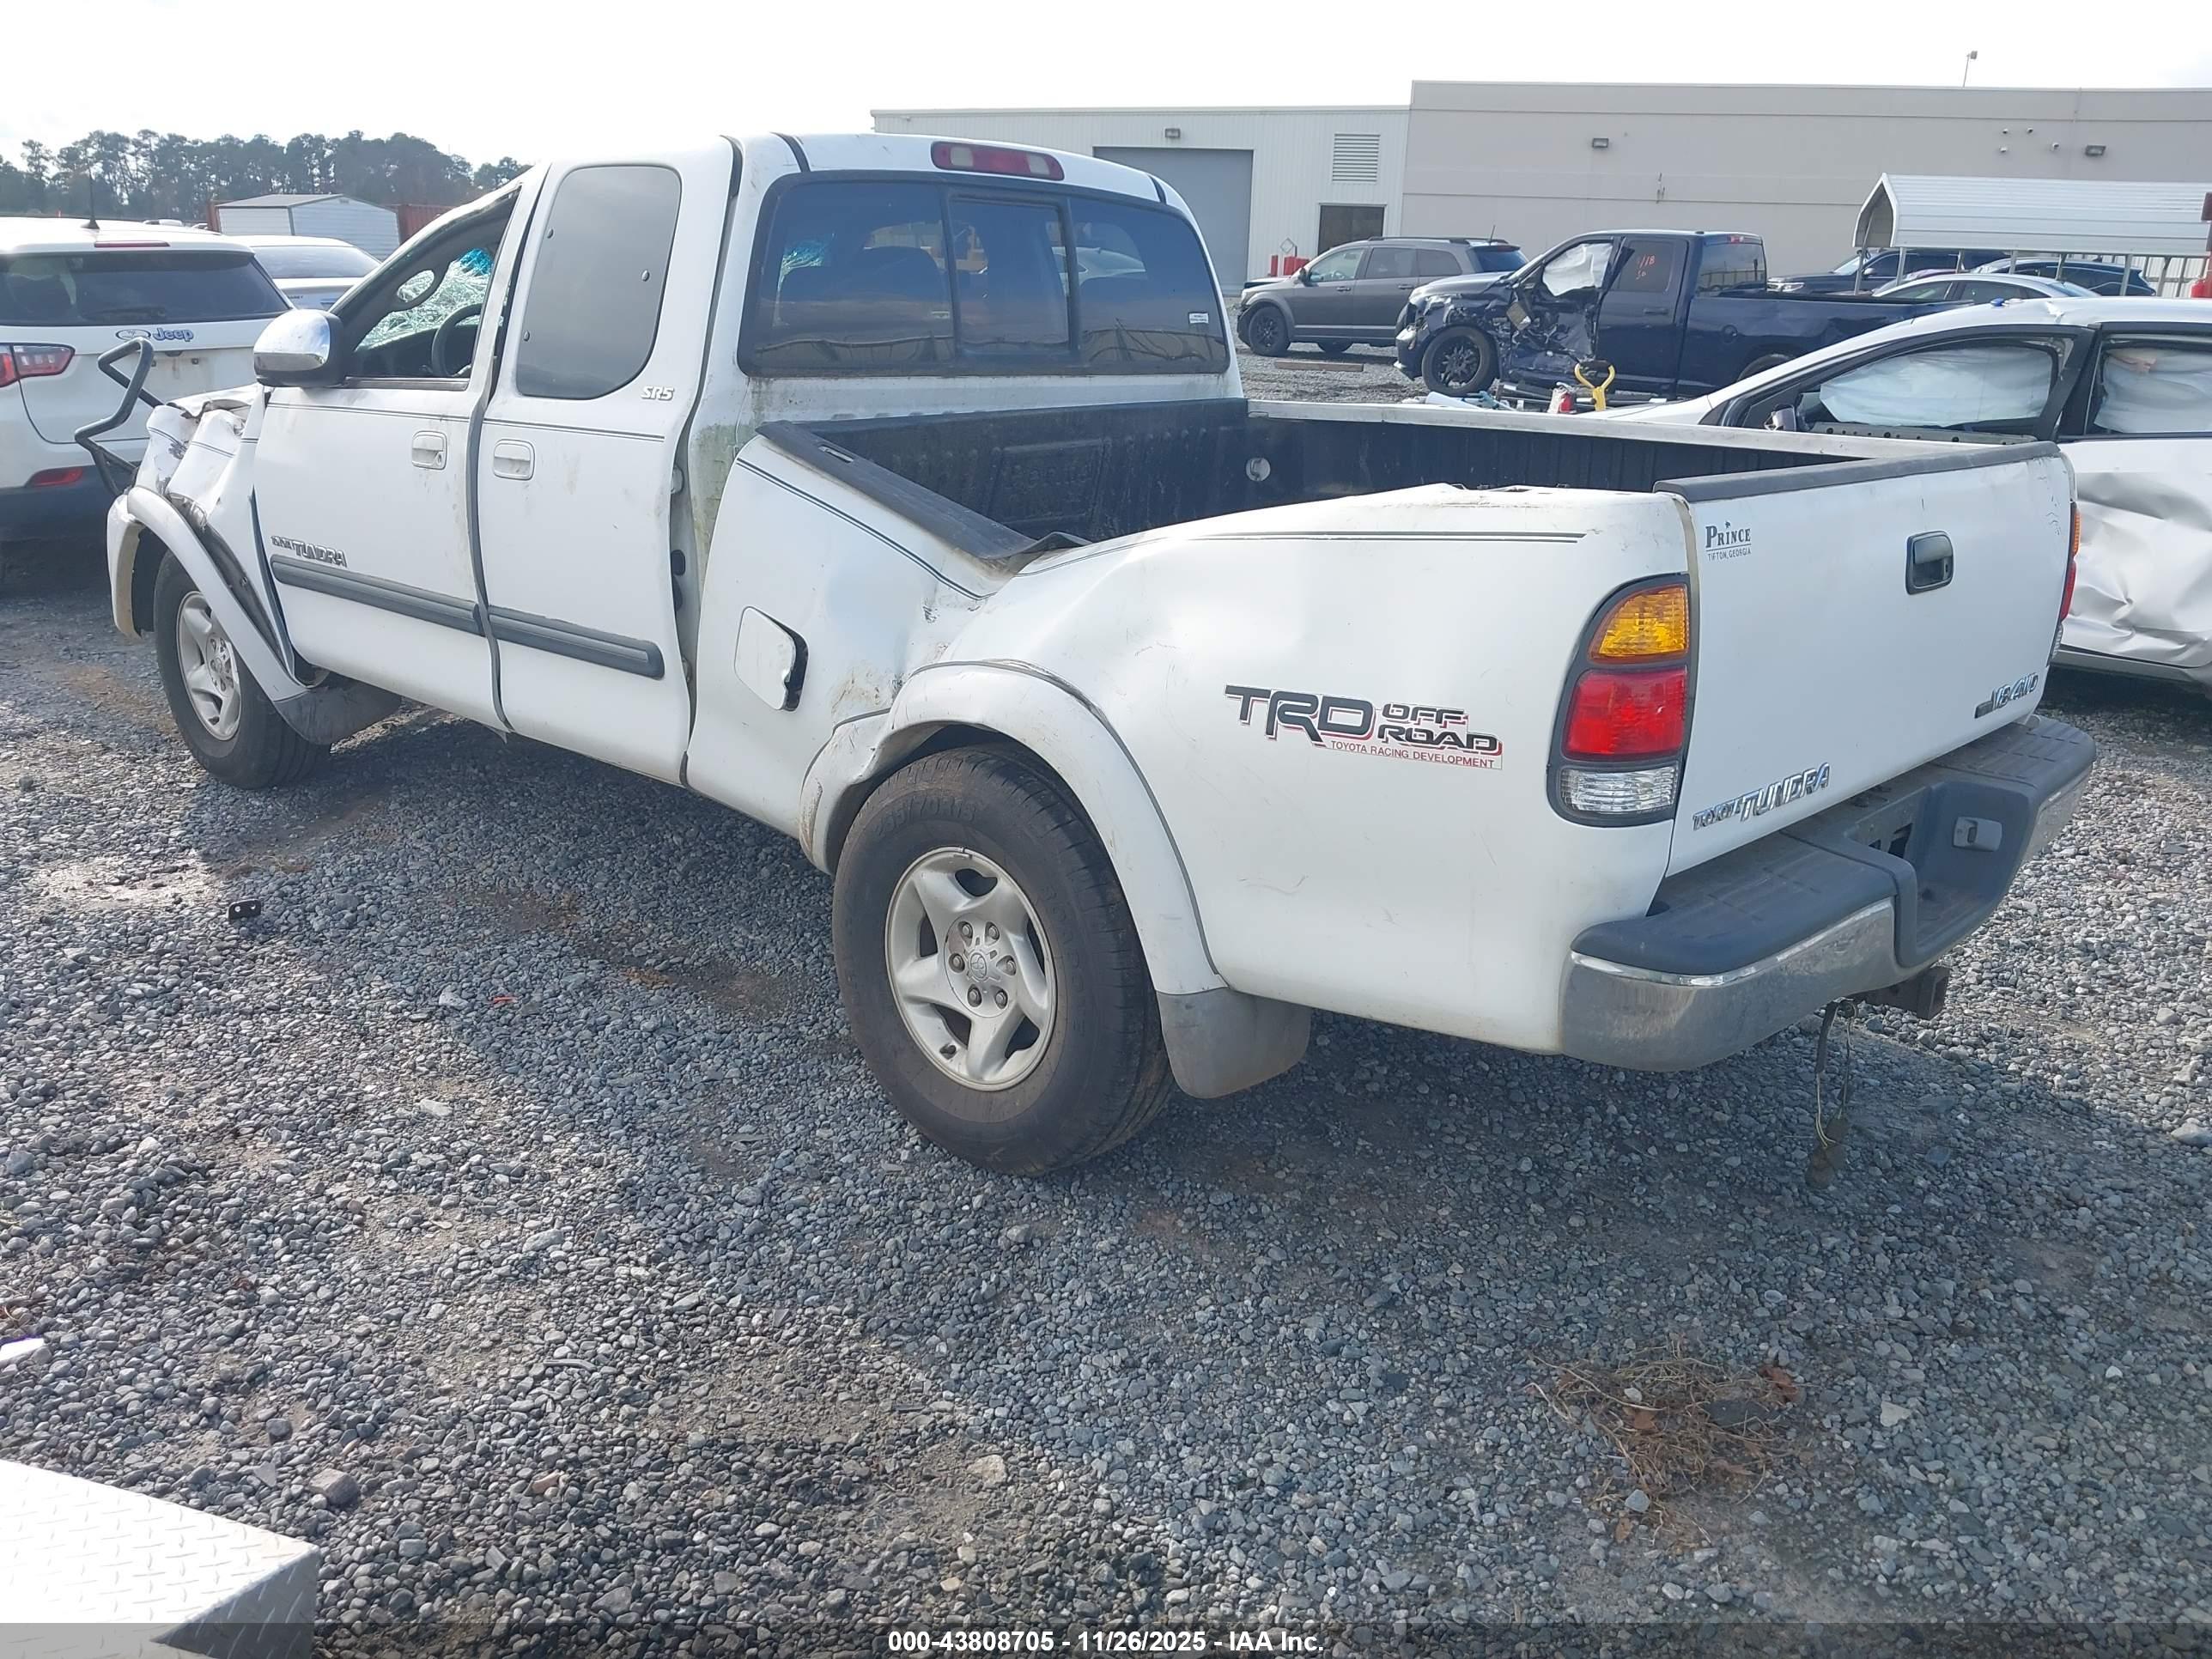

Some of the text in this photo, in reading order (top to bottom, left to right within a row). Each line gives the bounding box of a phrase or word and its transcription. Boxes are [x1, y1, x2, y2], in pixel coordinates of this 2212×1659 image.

[153, 327, 194, 342] Jeep
[641, 386, 675, 401] SR5
[1224, 684, 1376, 747] TRD
[1382, 702, 1468, 728] OFF
[1330, 740, 1496, 769] TOYOTA RACING DEVELOPMENT
[1377, 723, 1503, 757] ROAD
[1741, 762, 1830, 822] TUNDRA
